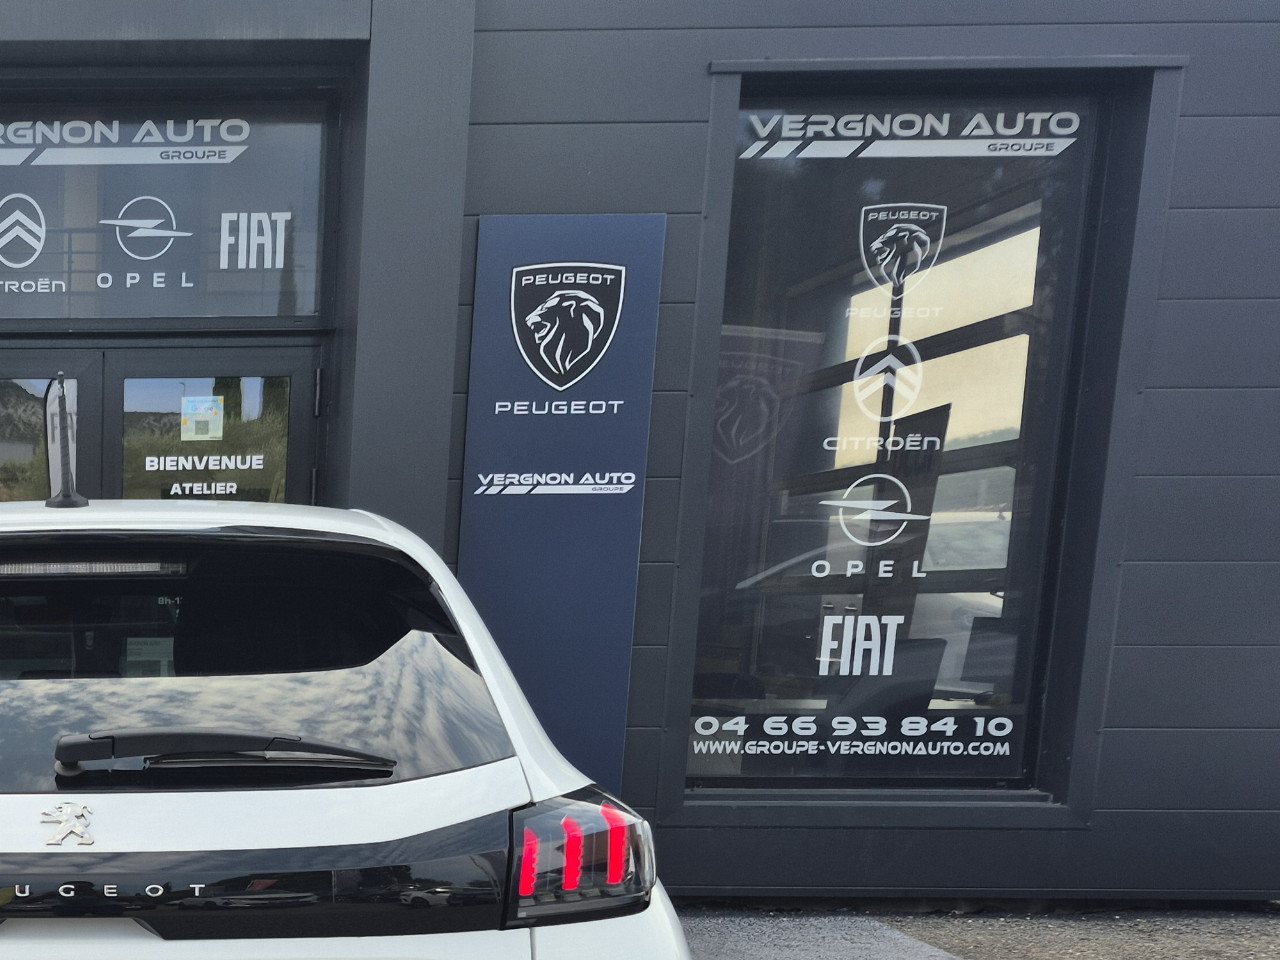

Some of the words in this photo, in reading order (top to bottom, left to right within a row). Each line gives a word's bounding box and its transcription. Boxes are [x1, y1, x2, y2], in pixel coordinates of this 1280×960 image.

[132, 118, 251, 144] AUTO
[750, 113, 950, 138] VERGNON
[960, 111, 1081, 136] AUTO
[160, 150, 227, 160] GROUPE
[987, 143, 1055, 152] GROUPE
[868, 210, 940, 221] PEUGEOT
[220, 212, 291, 269] FIAT
[97, 272, 194, 288] OPEL
[521, 273, 616, 286] PEUGEOT
[845, 306, 944, 318] PEUGEOT
[494, 400, 624, 415] PEUGEOT
[145, 455, 264, 471] BIENVENUE
[477, 473, 574, 485] VERGNON
[579, 472, 636, 485] AUTO
[170, 482, 238, 496] ATELIER
[811, 560, 927, 578] OPEL
[819, 615, 905, 676] FIAT
[694, 716, 749, 736] 04
[762, 716, 818, 736] 66
[831, 716, 887, 736] 93
[900, 716, 957, 736] 84
[973, 717, 1014, 737] 10
[693, 740, 1010, 756] WWW.GROUPE-VERGNONAUTO.COM
